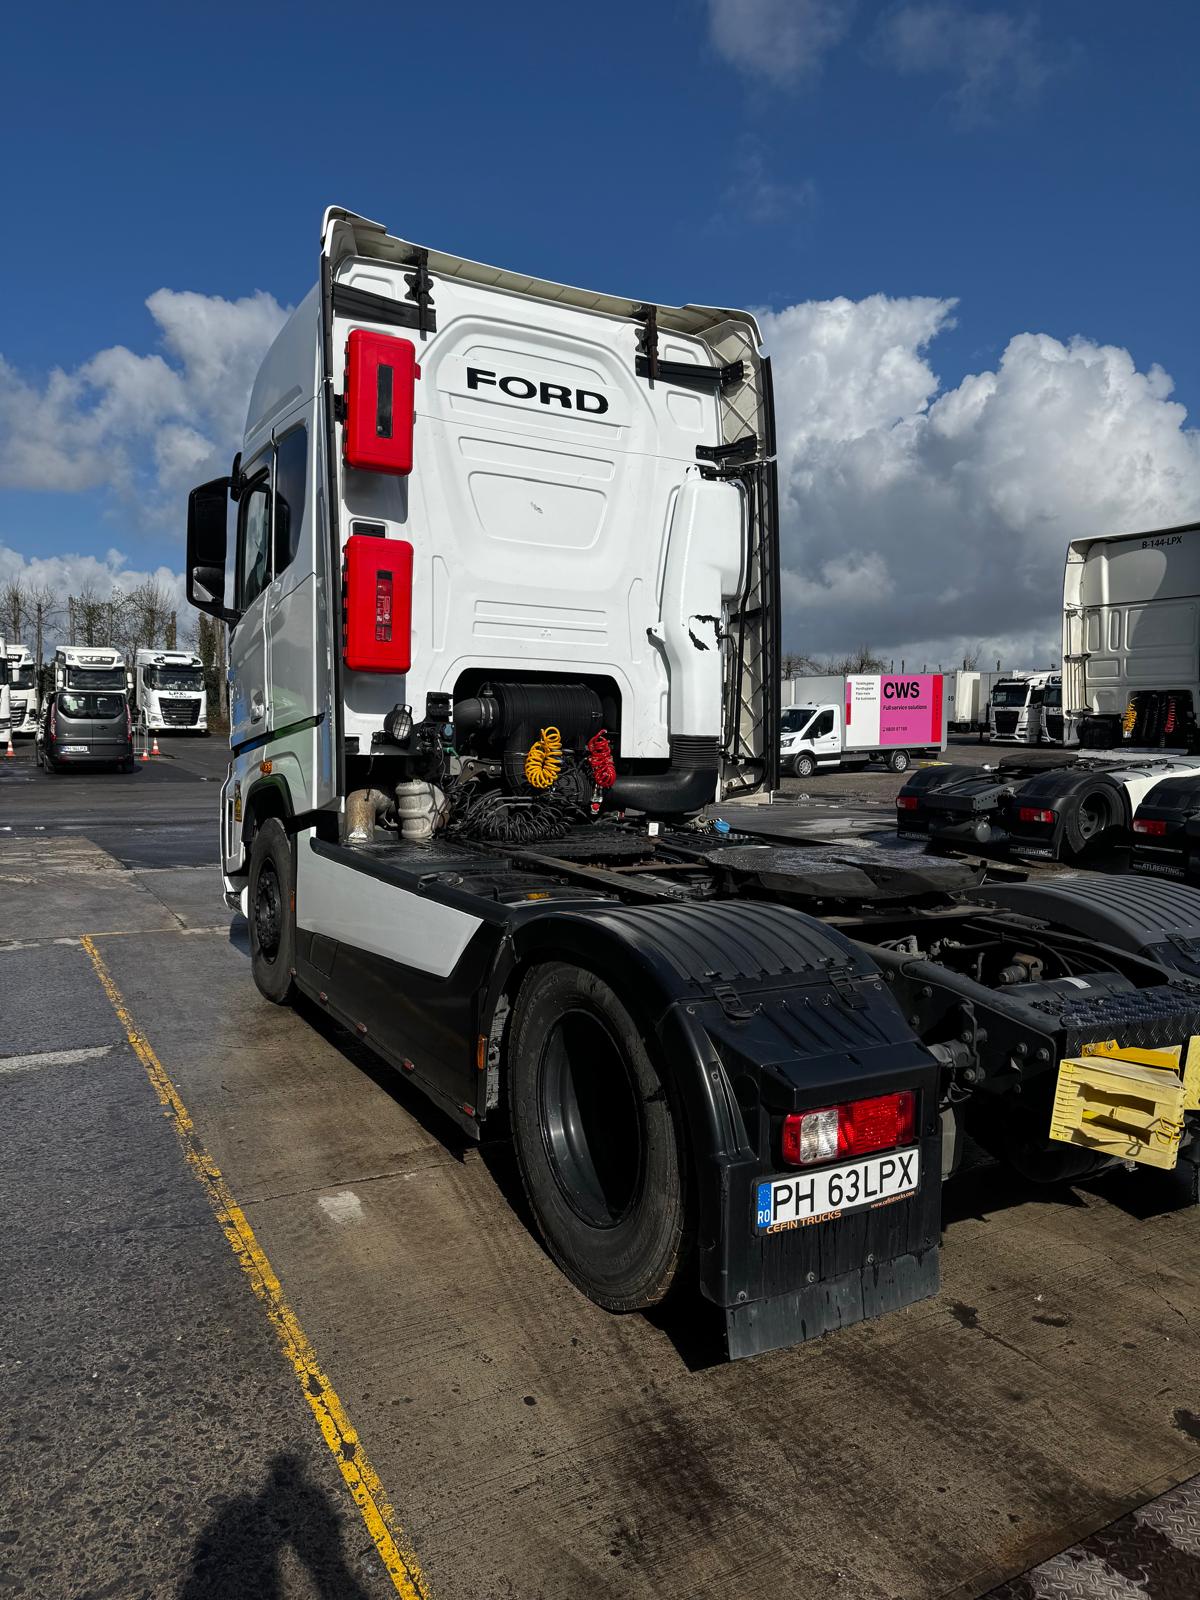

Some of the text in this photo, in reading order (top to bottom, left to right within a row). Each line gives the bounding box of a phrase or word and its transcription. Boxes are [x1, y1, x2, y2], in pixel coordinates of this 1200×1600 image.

[466, 366, 609, 414] FORD
[1141, 535, 1183, 549] B-144-LPX
[883, 682, 920, 699] CWS
[773, 1178, 815, 1220] PH
[757, 1209, 771, 1225] RO
[766, 1209, 842, 1235] CEFIN TRUCKS
